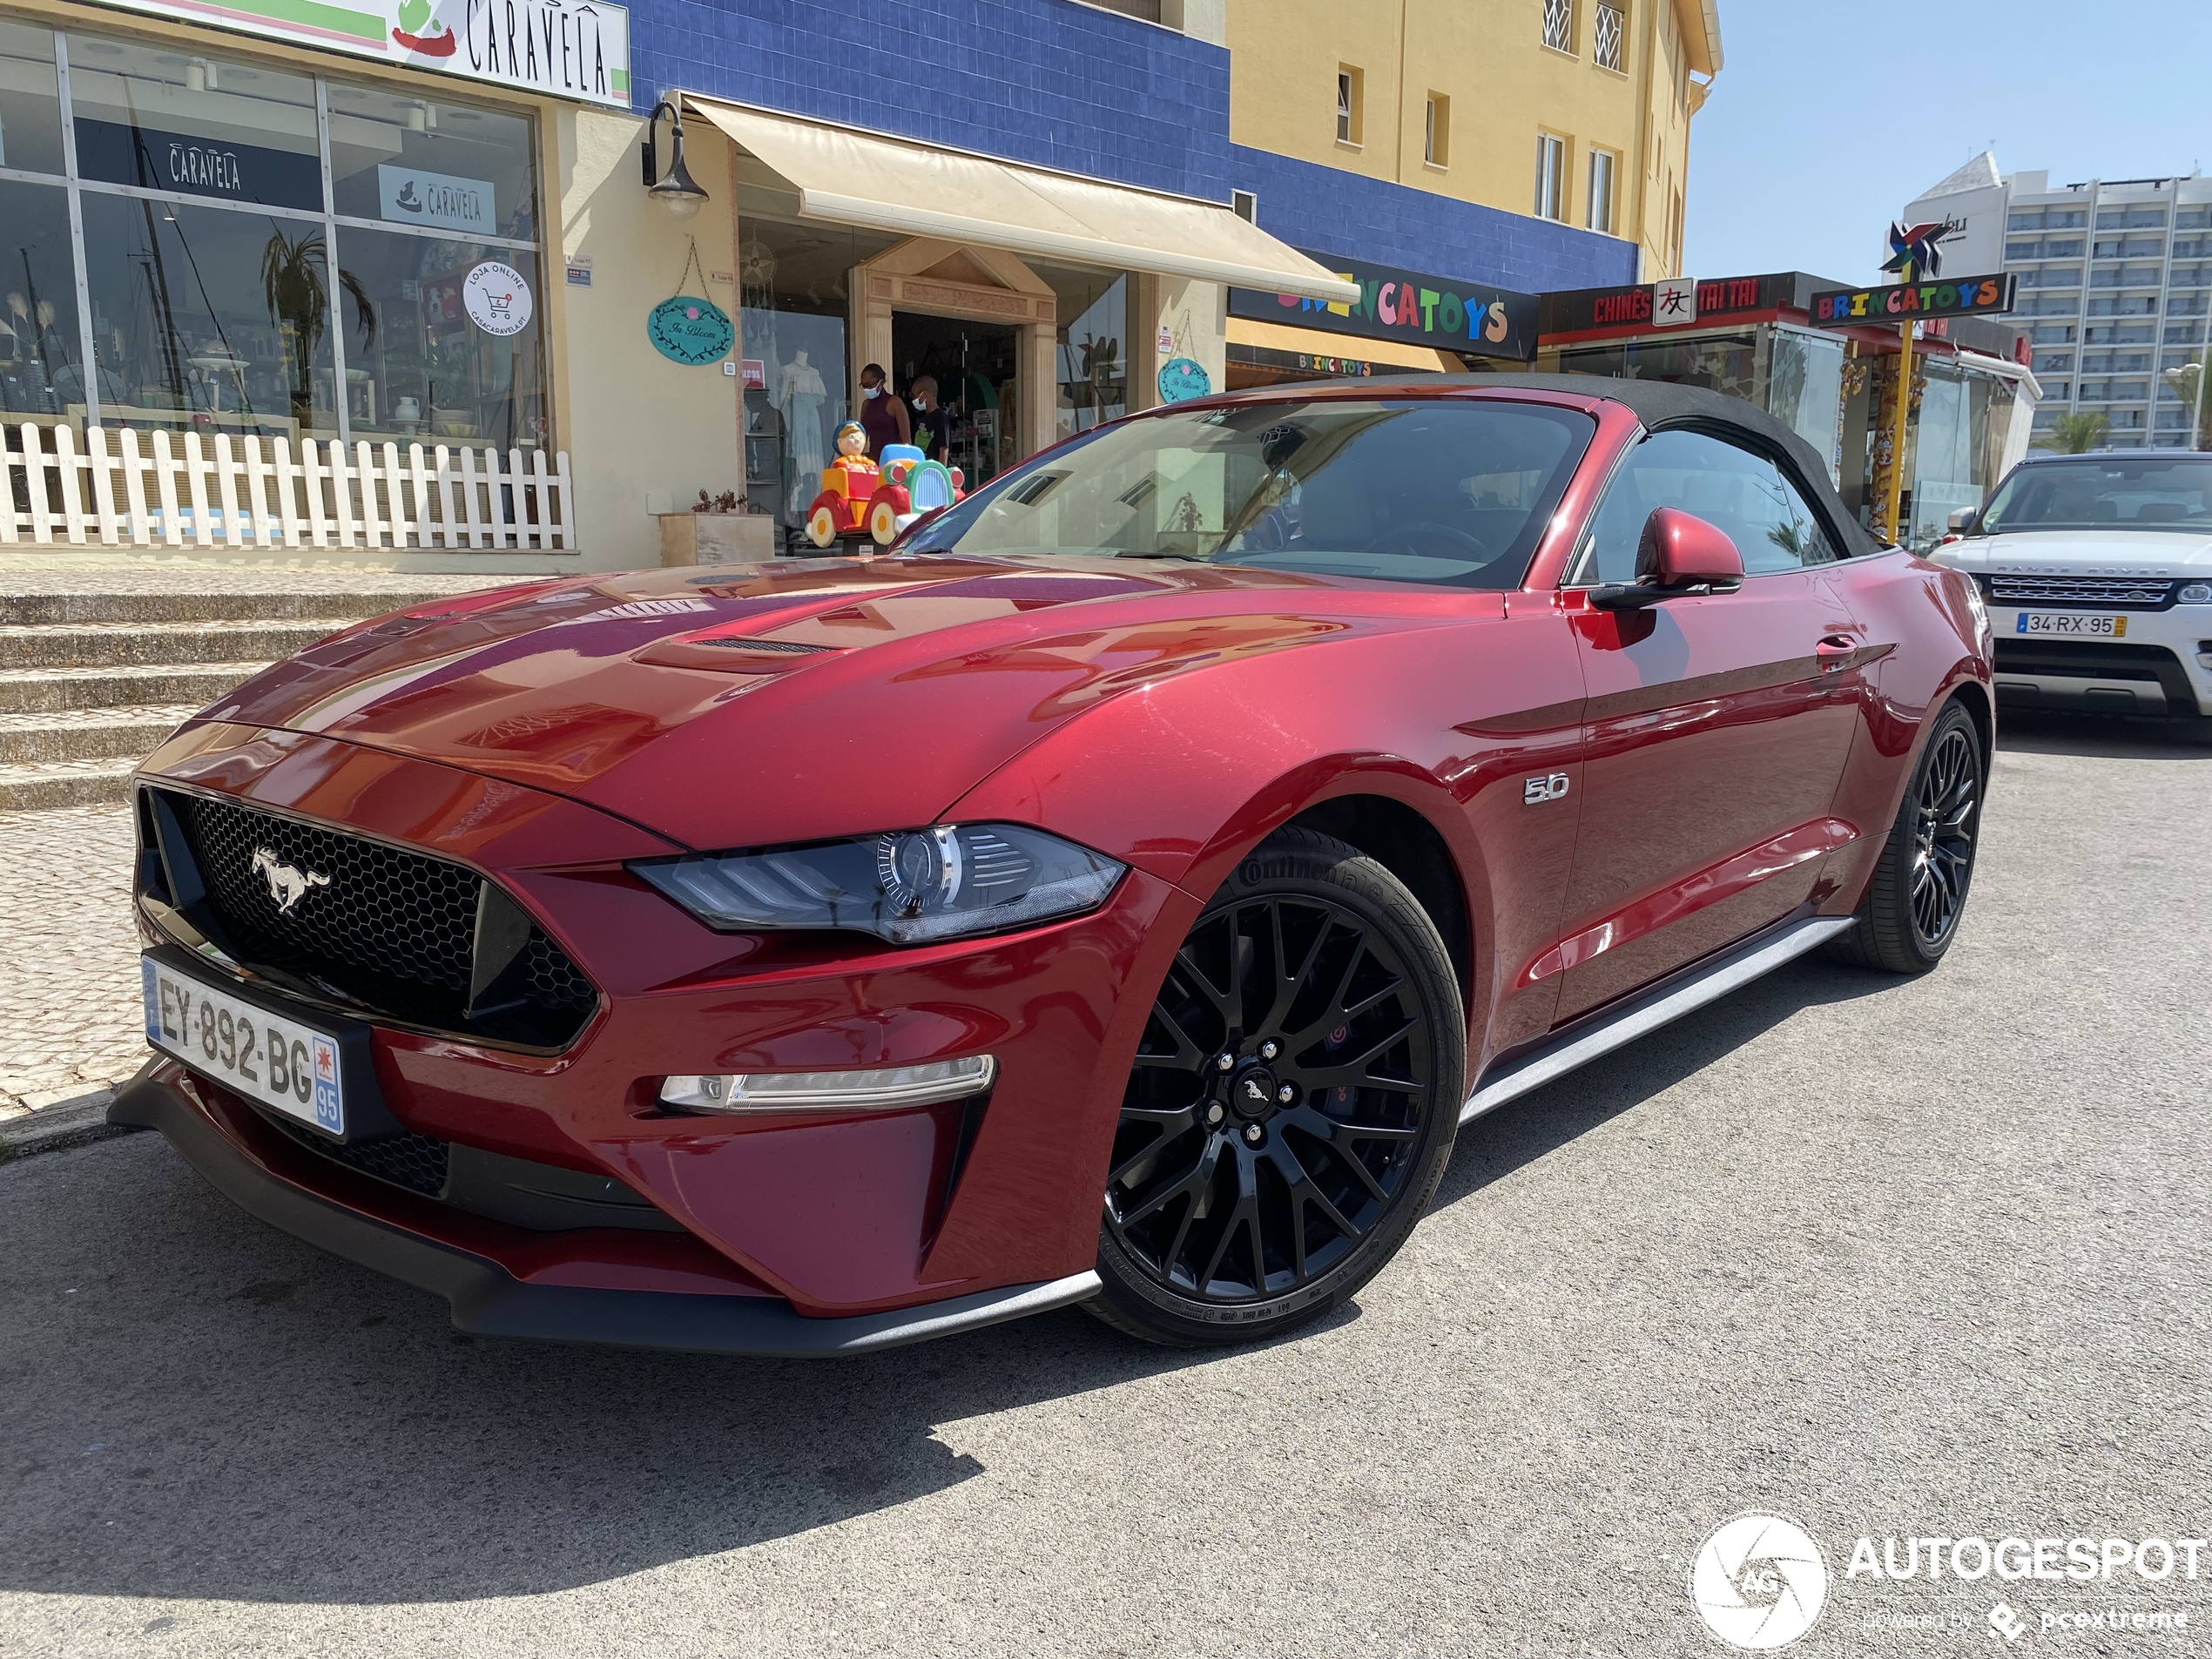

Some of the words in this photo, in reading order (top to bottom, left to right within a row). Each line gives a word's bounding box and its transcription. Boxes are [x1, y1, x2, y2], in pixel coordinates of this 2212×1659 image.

[467, 0, 607, 96] CARAVELA
[170, 148, 241, 191] CARAVELA
[428, 187, 482, 221] CARAVELA
[469, 265, 489, 286] LOJA
[491, 265, 524, 291] ONLINE
[1698, 282, 1726, 312] TAI
[1729, 278, 1759, 307] TAI
[1594, 289, 1652, 323] CHINÊS
[1817, 280, 1999, 320] BRINCATOYS
[470, 315, 527, 334] CASACARAVELA.PT
[668, 322, 683, 334] In
[684, 324, 717, 341] Bloom
[1298, 354, 1372, 377] BRINCATOYS
[1180, 379, 1200, 391] Bloom
[1997, 565, 2072, 574] RANGE
[2087, 566, 2170, 577] ROVER
[1523, 772, 1570, 806] 5.0
[1238, 854, 1367, 897] Continental
[317, 1085, 338, 1122] 95
